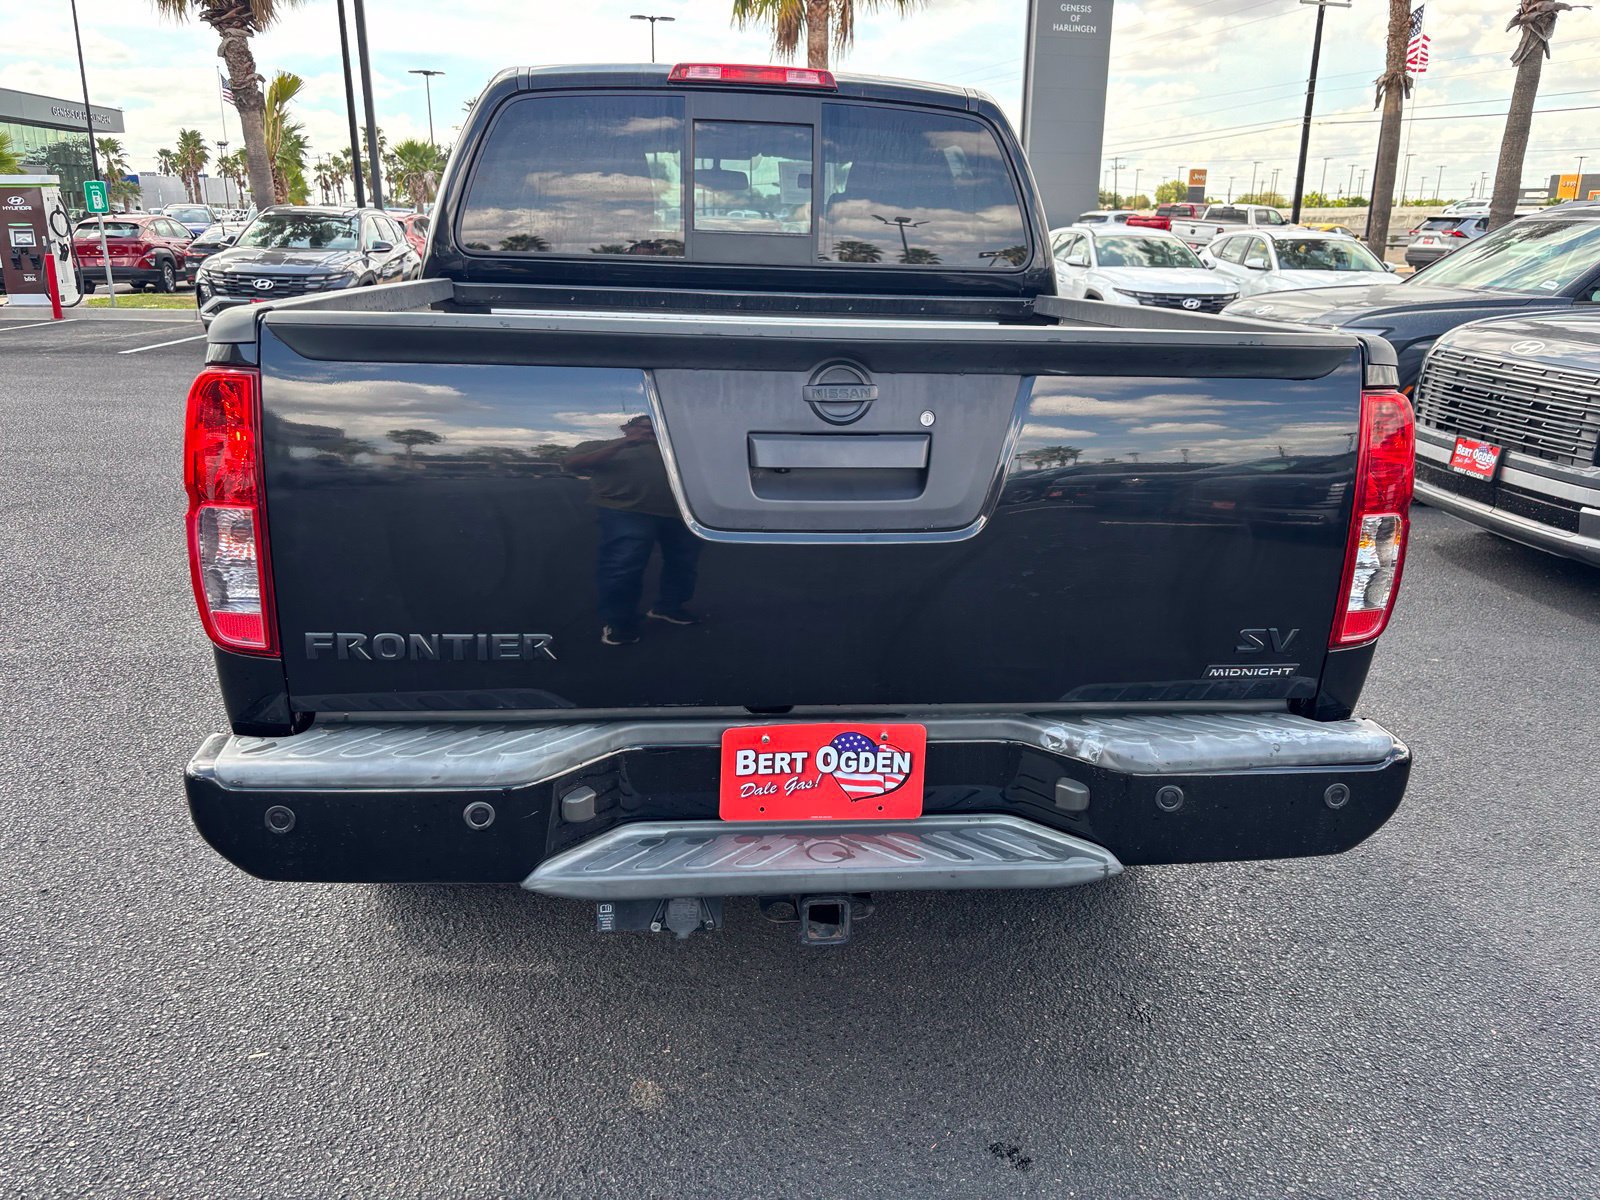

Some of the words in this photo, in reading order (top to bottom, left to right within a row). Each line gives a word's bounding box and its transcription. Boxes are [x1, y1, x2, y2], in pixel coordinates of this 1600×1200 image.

[1060, 4, 1092, 13] GENESIS
[1070, 14, 1081, 22] OF
[1052, 23, 1097, 33] HARLINGEN
[811, 388, 871, 399] NISSAN
[1455, 443, 1473, 457] BERT
[1472, 447, 1497, 465] OGDEN
[1453, 466, 1467, 474] BERT
[1466, 470, 1485, 480] OGDEN
[304, 632, 558, 661] FRONTIER
[1234, 627, 1301, 654] SV
[1208, 667, 1294, 677] MIDNIGHT
[735, 749, 809, 776] BERT
[815, 745, 911, 774] OGDEN
[740, 781, 778, 798] Dale
[783, 773, 823, 797] Gas!
